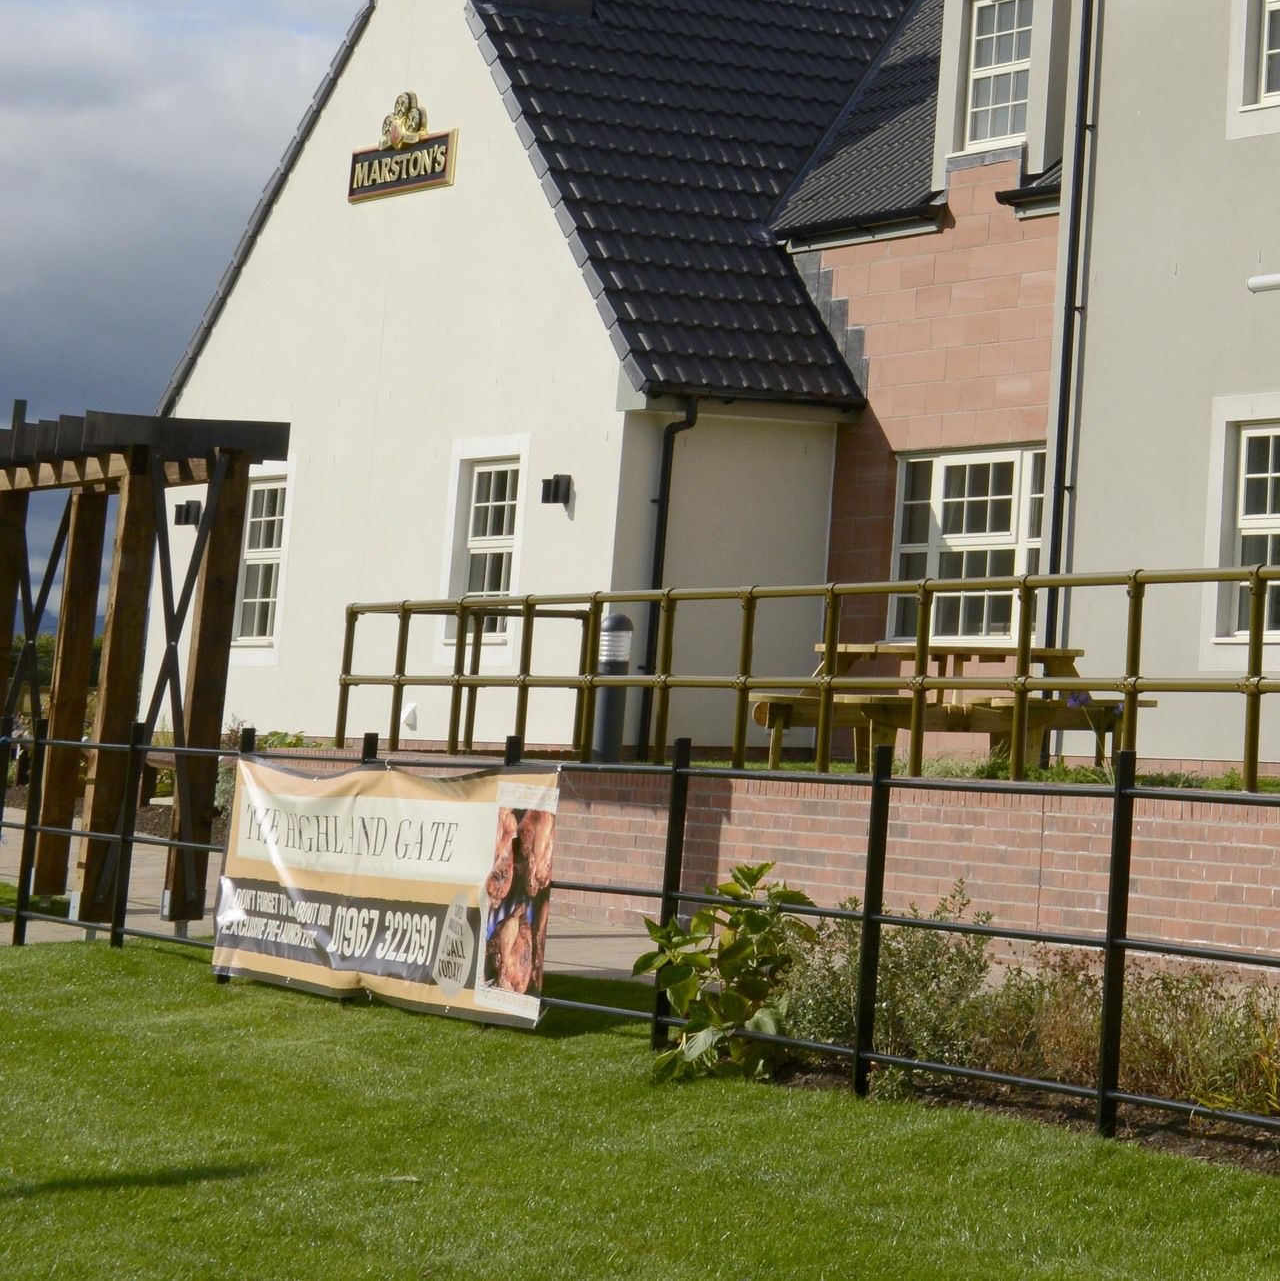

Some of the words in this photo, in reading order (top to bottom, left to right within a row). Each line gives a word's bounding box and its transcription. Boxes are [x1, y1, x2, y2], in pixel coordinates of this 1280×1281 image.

[353, 144, 446, 188] MARSTON'S
[395, 819, 459, 862] GATE
[326, 905, 380, 957] 01967
[376, 910, 437, 966] 322691
